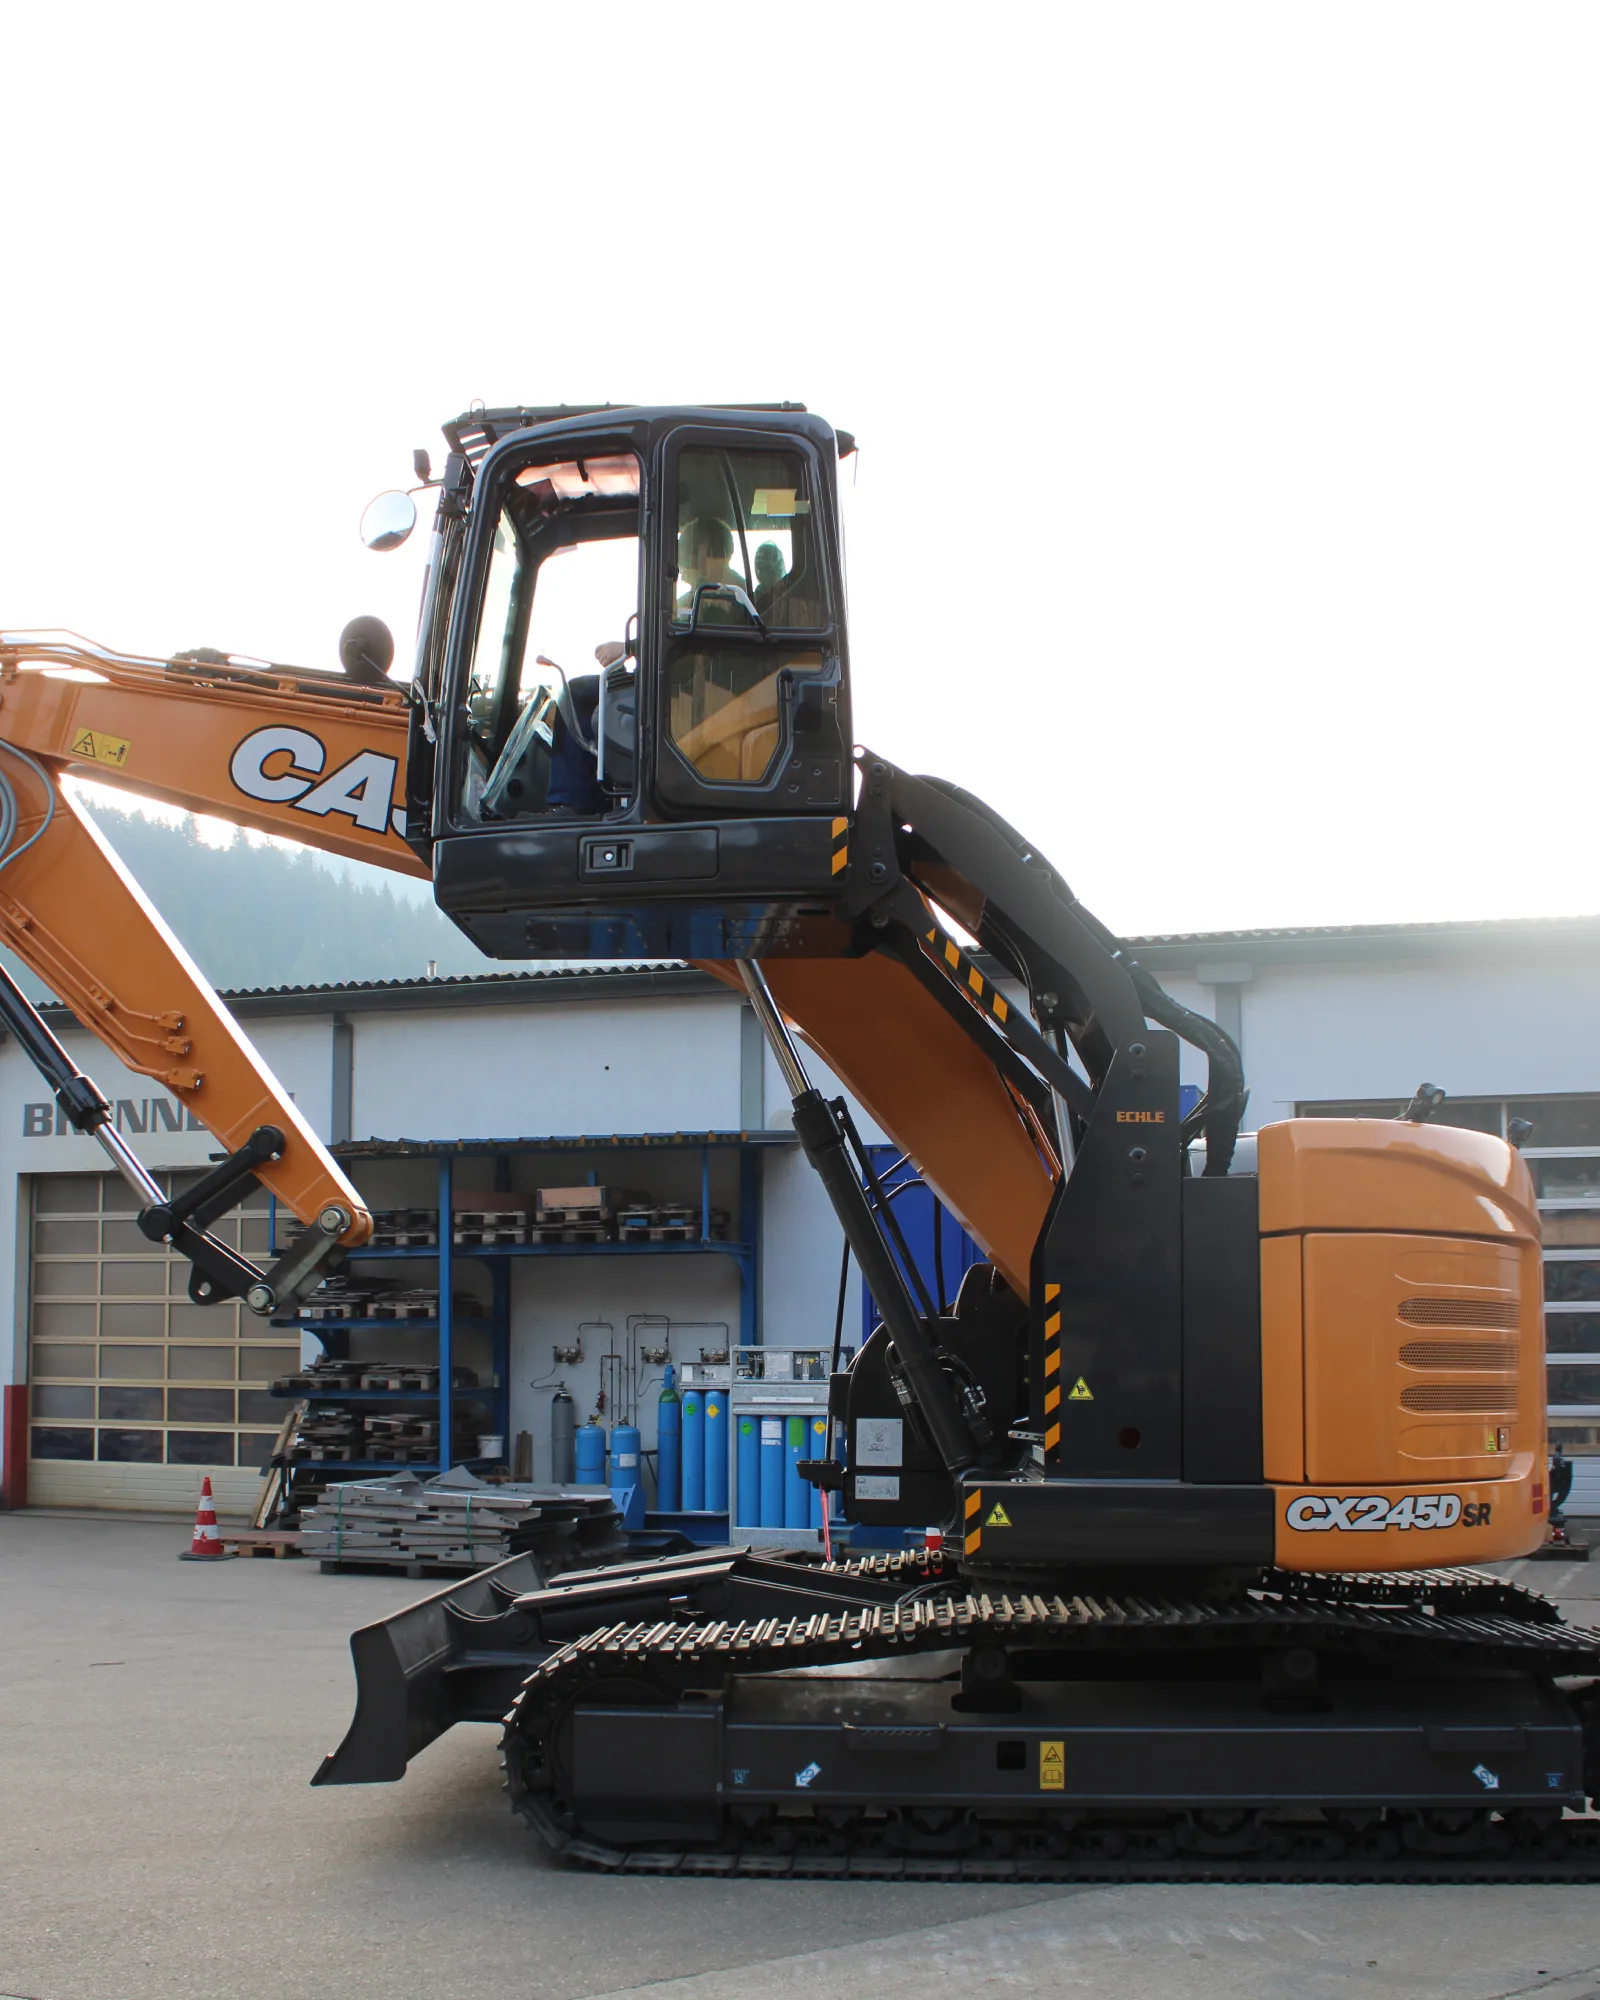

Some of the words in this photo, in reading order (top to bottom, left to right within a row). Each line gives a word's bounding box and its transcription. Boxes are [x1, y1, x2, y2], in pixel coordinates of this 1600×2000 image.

[229, 724, 408, 840] CA
[1116, 1111, 1165, 1123] ECHLE
[1286, 1493, 1462, 1532] CX245D
[1461, 1502, 1492, 1527] SR
